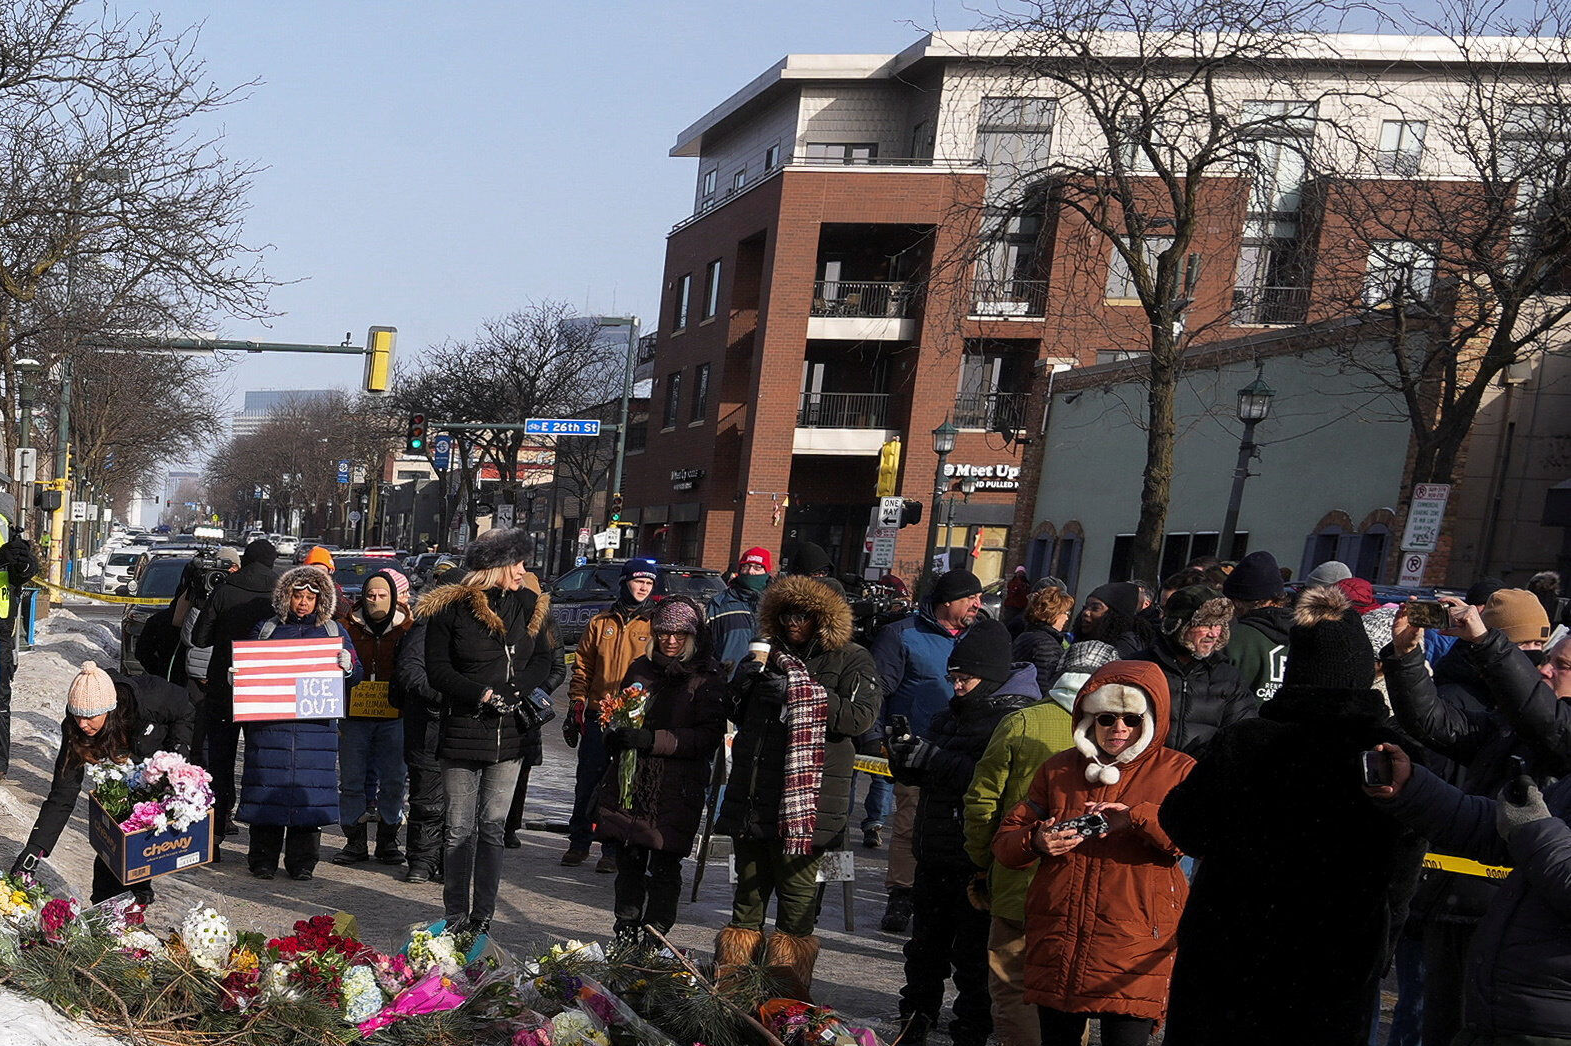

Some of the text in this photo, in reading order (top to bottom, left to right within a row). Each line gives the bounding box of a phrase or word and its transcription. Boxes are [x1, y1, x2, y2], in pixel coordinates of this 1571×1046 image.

[541, 422, 597, 432] E 26th St
[956, 464, 1020, 479] Meet Up
[883, 508, 899, 516] WAY
[552, 609, 599, 625] POLICE
[302, 678, 334, 697] ICE
[299, 697, 340, 716] OUT
[142, 835, 192, 857] chewy
